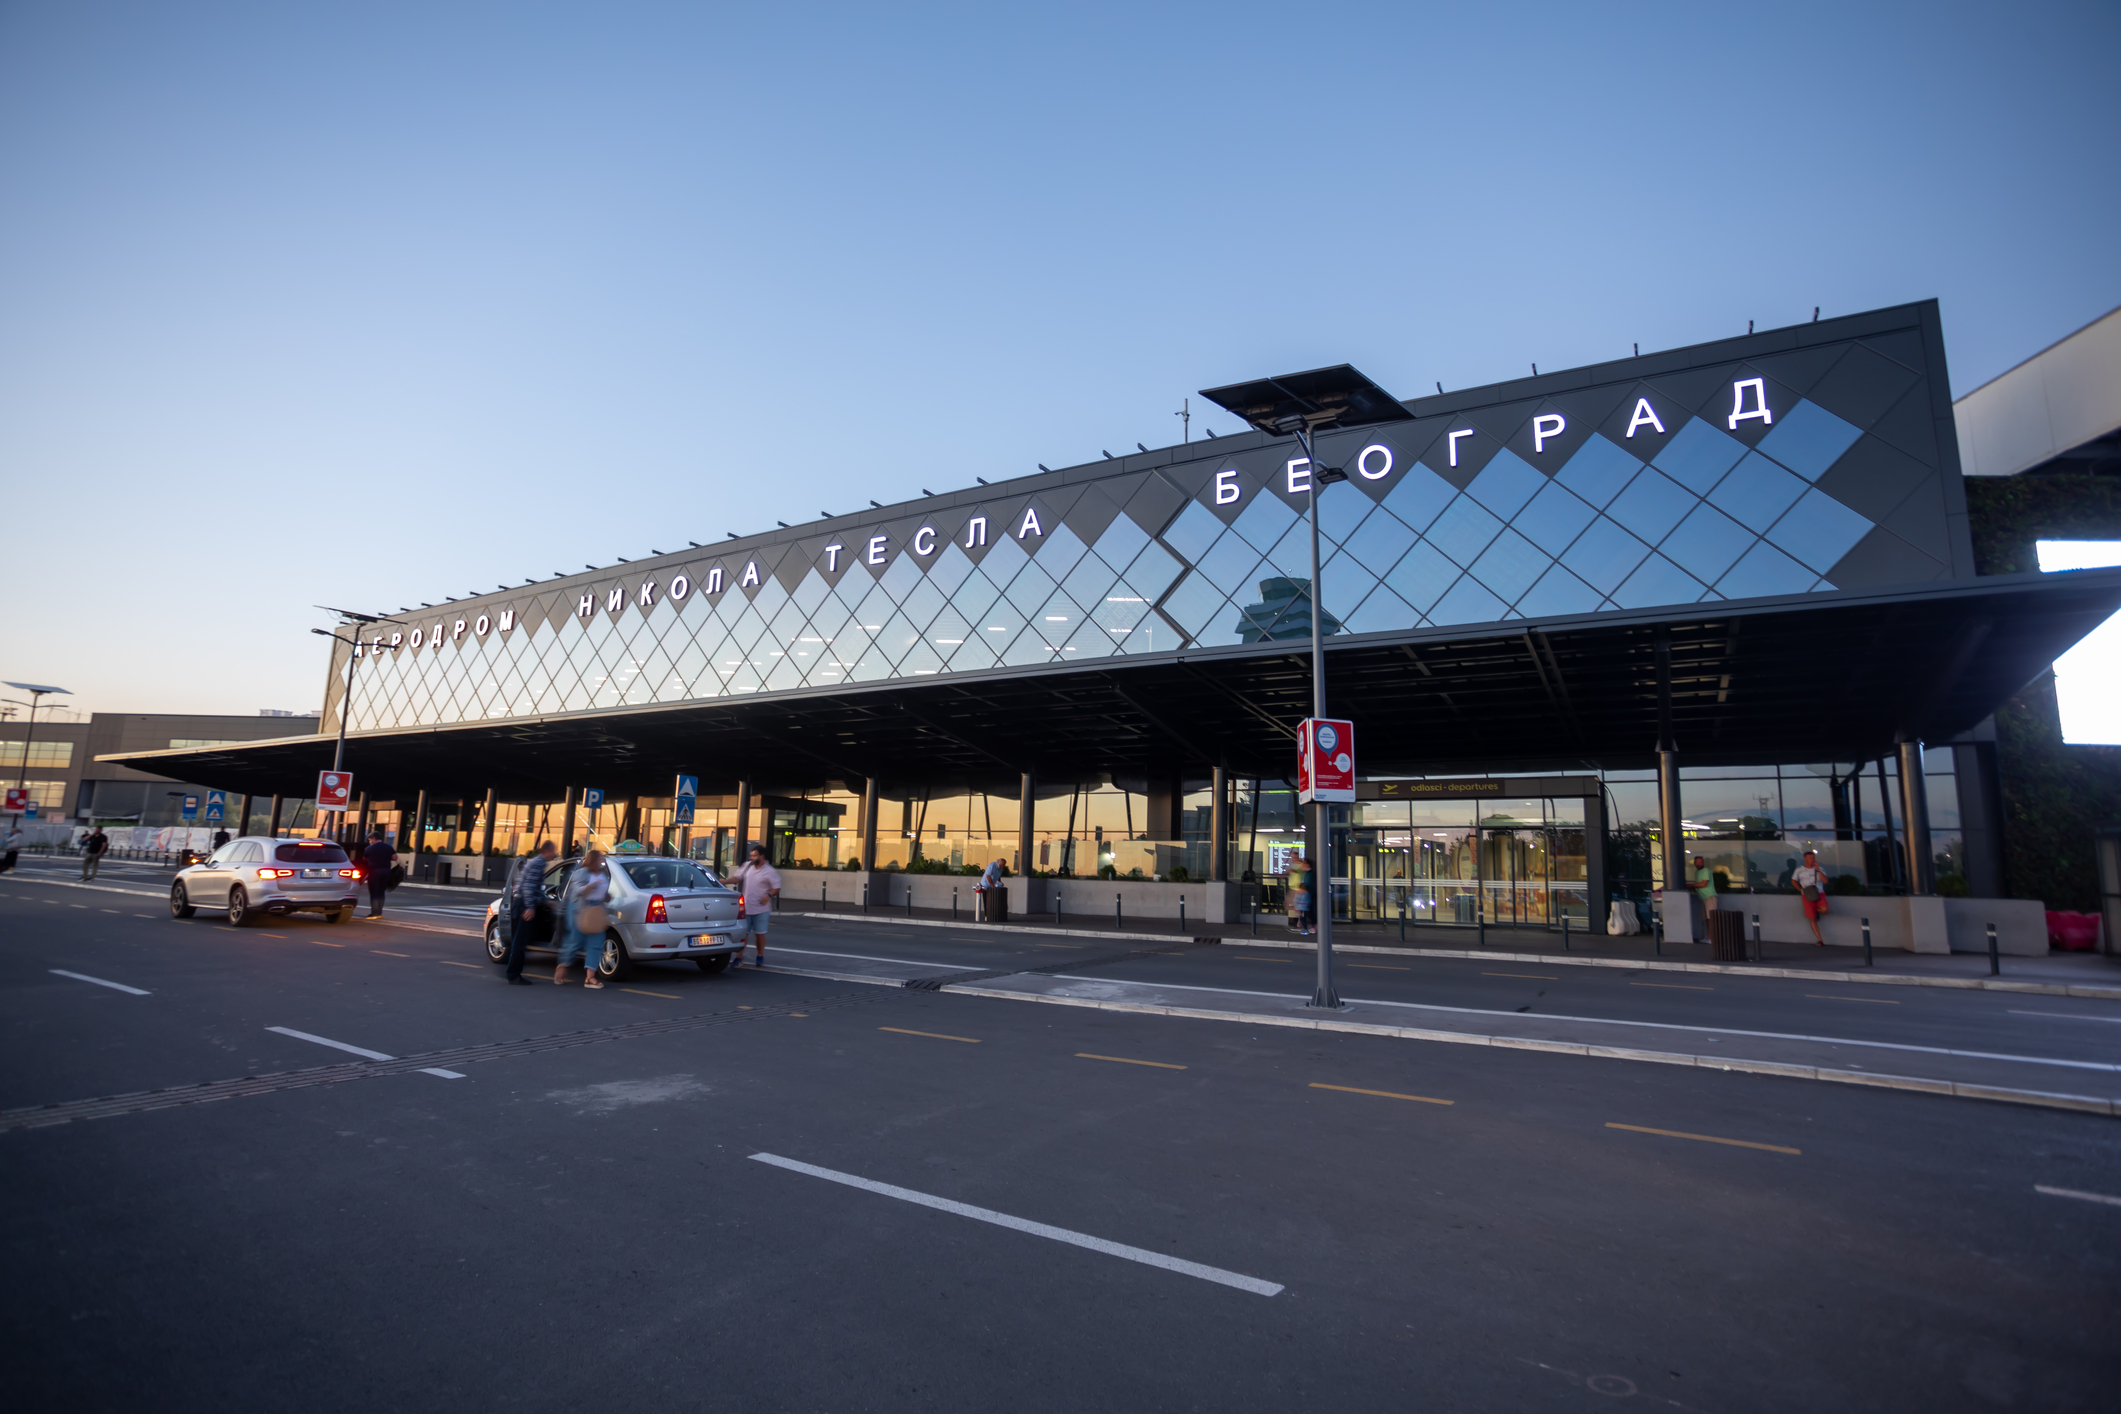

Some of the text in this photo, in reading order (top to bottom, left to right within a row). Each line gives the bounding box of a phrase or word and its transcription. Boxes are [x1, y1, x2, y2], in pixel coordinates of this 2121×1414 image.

[354, 378, 1773, 657] АЕРОДРОМ НИКОЛА ТЕСЛА БЕОГРАД
[1410, 783, 1442, 792] odlasci
[1447, 783, 1499, 793] departures
[588, 790, 600, 807] P
